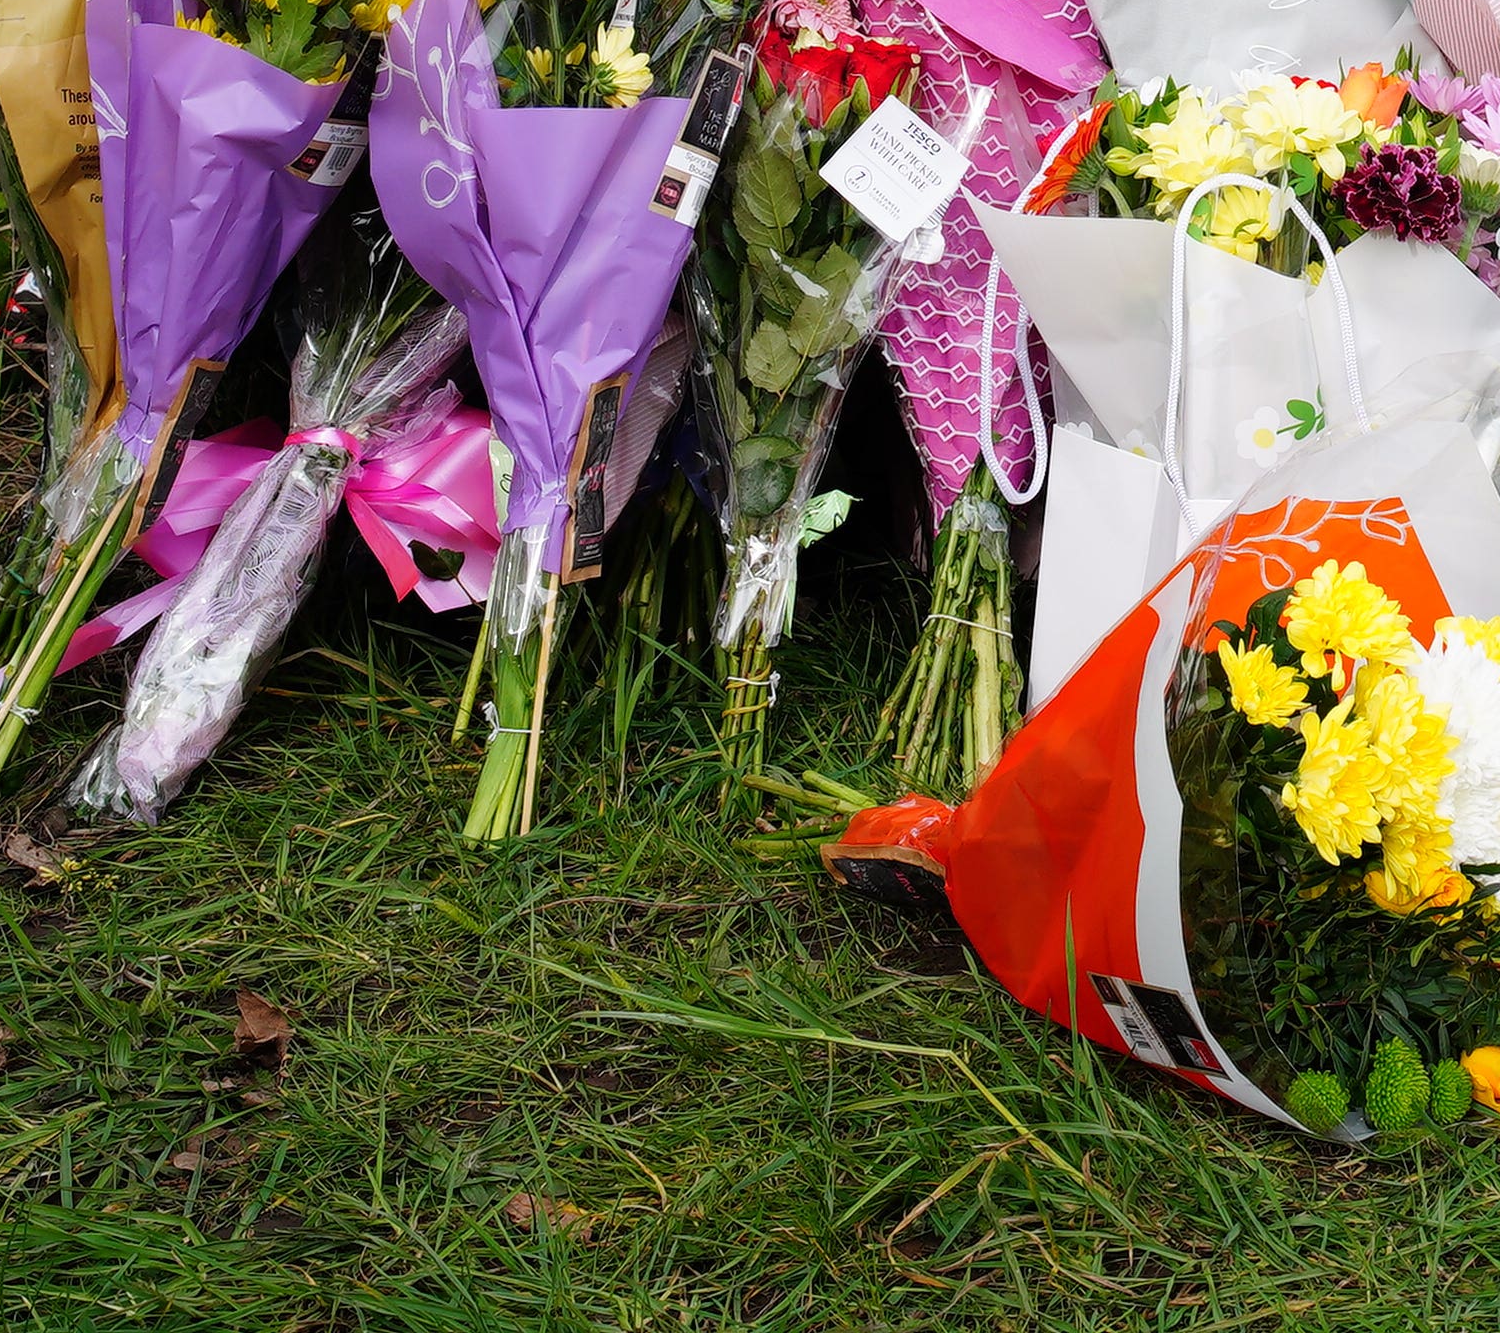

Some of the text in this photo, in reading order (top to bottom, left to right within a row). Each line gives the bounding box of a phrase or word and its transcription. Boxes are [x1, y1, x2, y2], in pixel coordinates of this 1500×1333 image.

[906, 120, 942, 154] TESCO
[855, 171, 866, 181] 7
[869, 137, 899, 167] WITH
[897, 162, 930, 193] CARE
